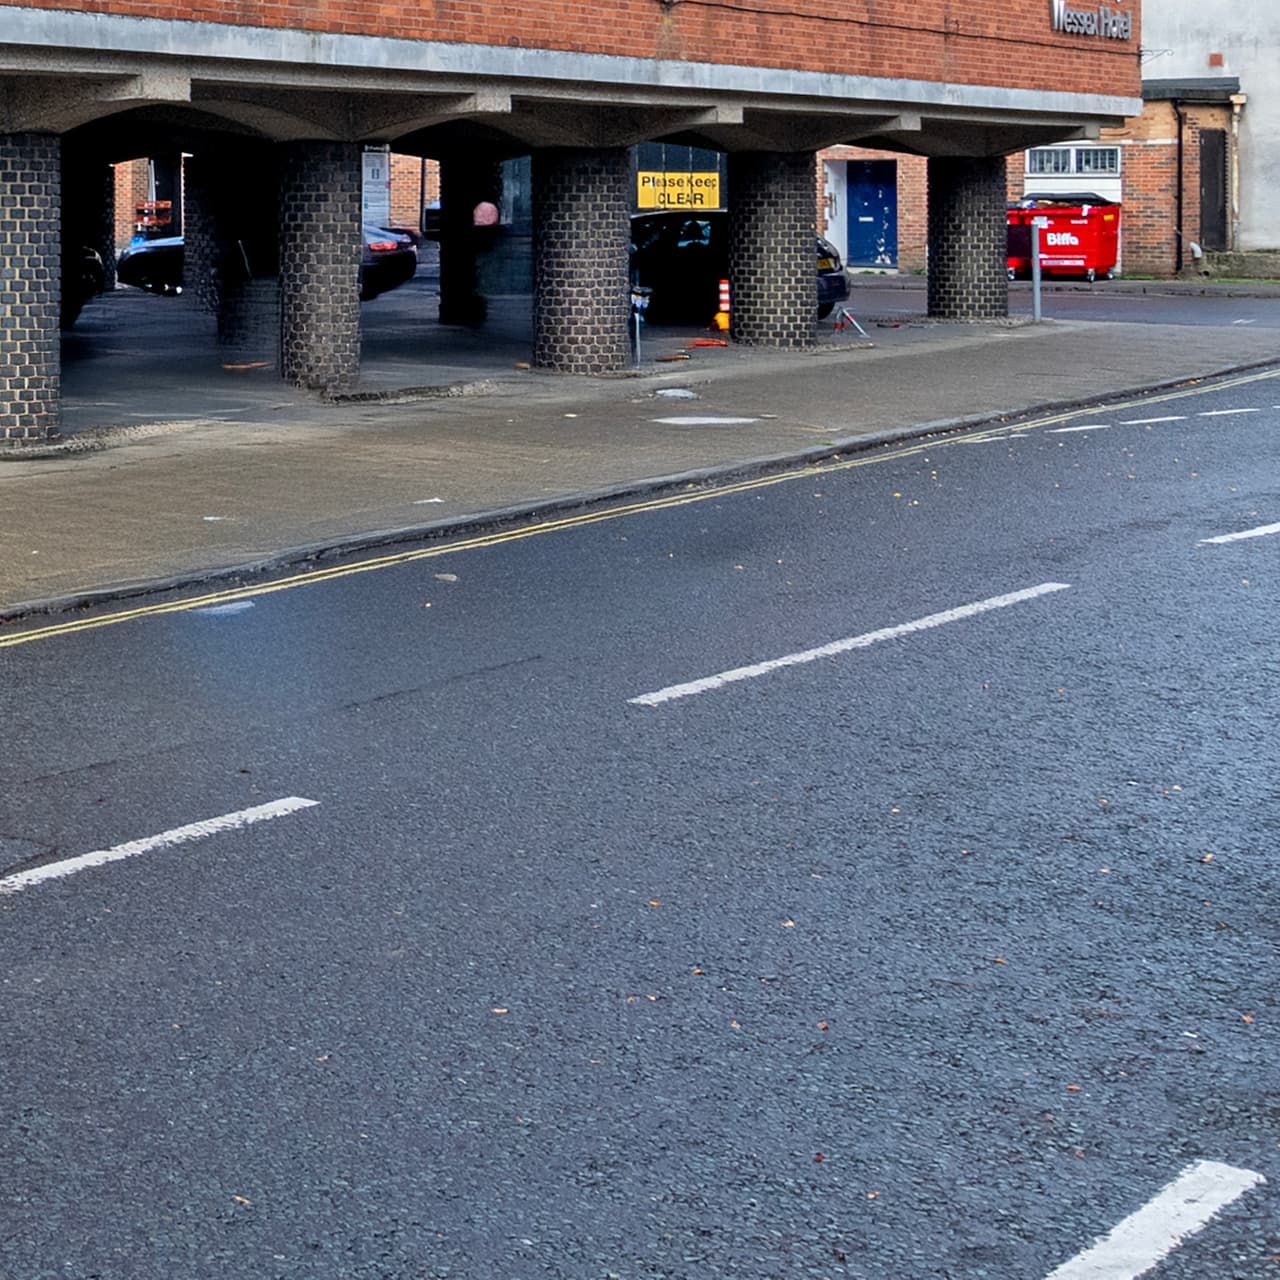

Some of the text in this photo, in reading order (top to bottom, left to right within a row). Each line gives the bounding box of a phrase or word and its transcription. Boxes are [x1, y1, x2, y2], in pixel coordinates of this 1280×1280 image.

[1098, 6, 1132, 40] Hotel
[641, 175, 685, 187] Please
[657, 192, 704, 205] CLEAR
[1046, 232, 1079, 246] Biffa
